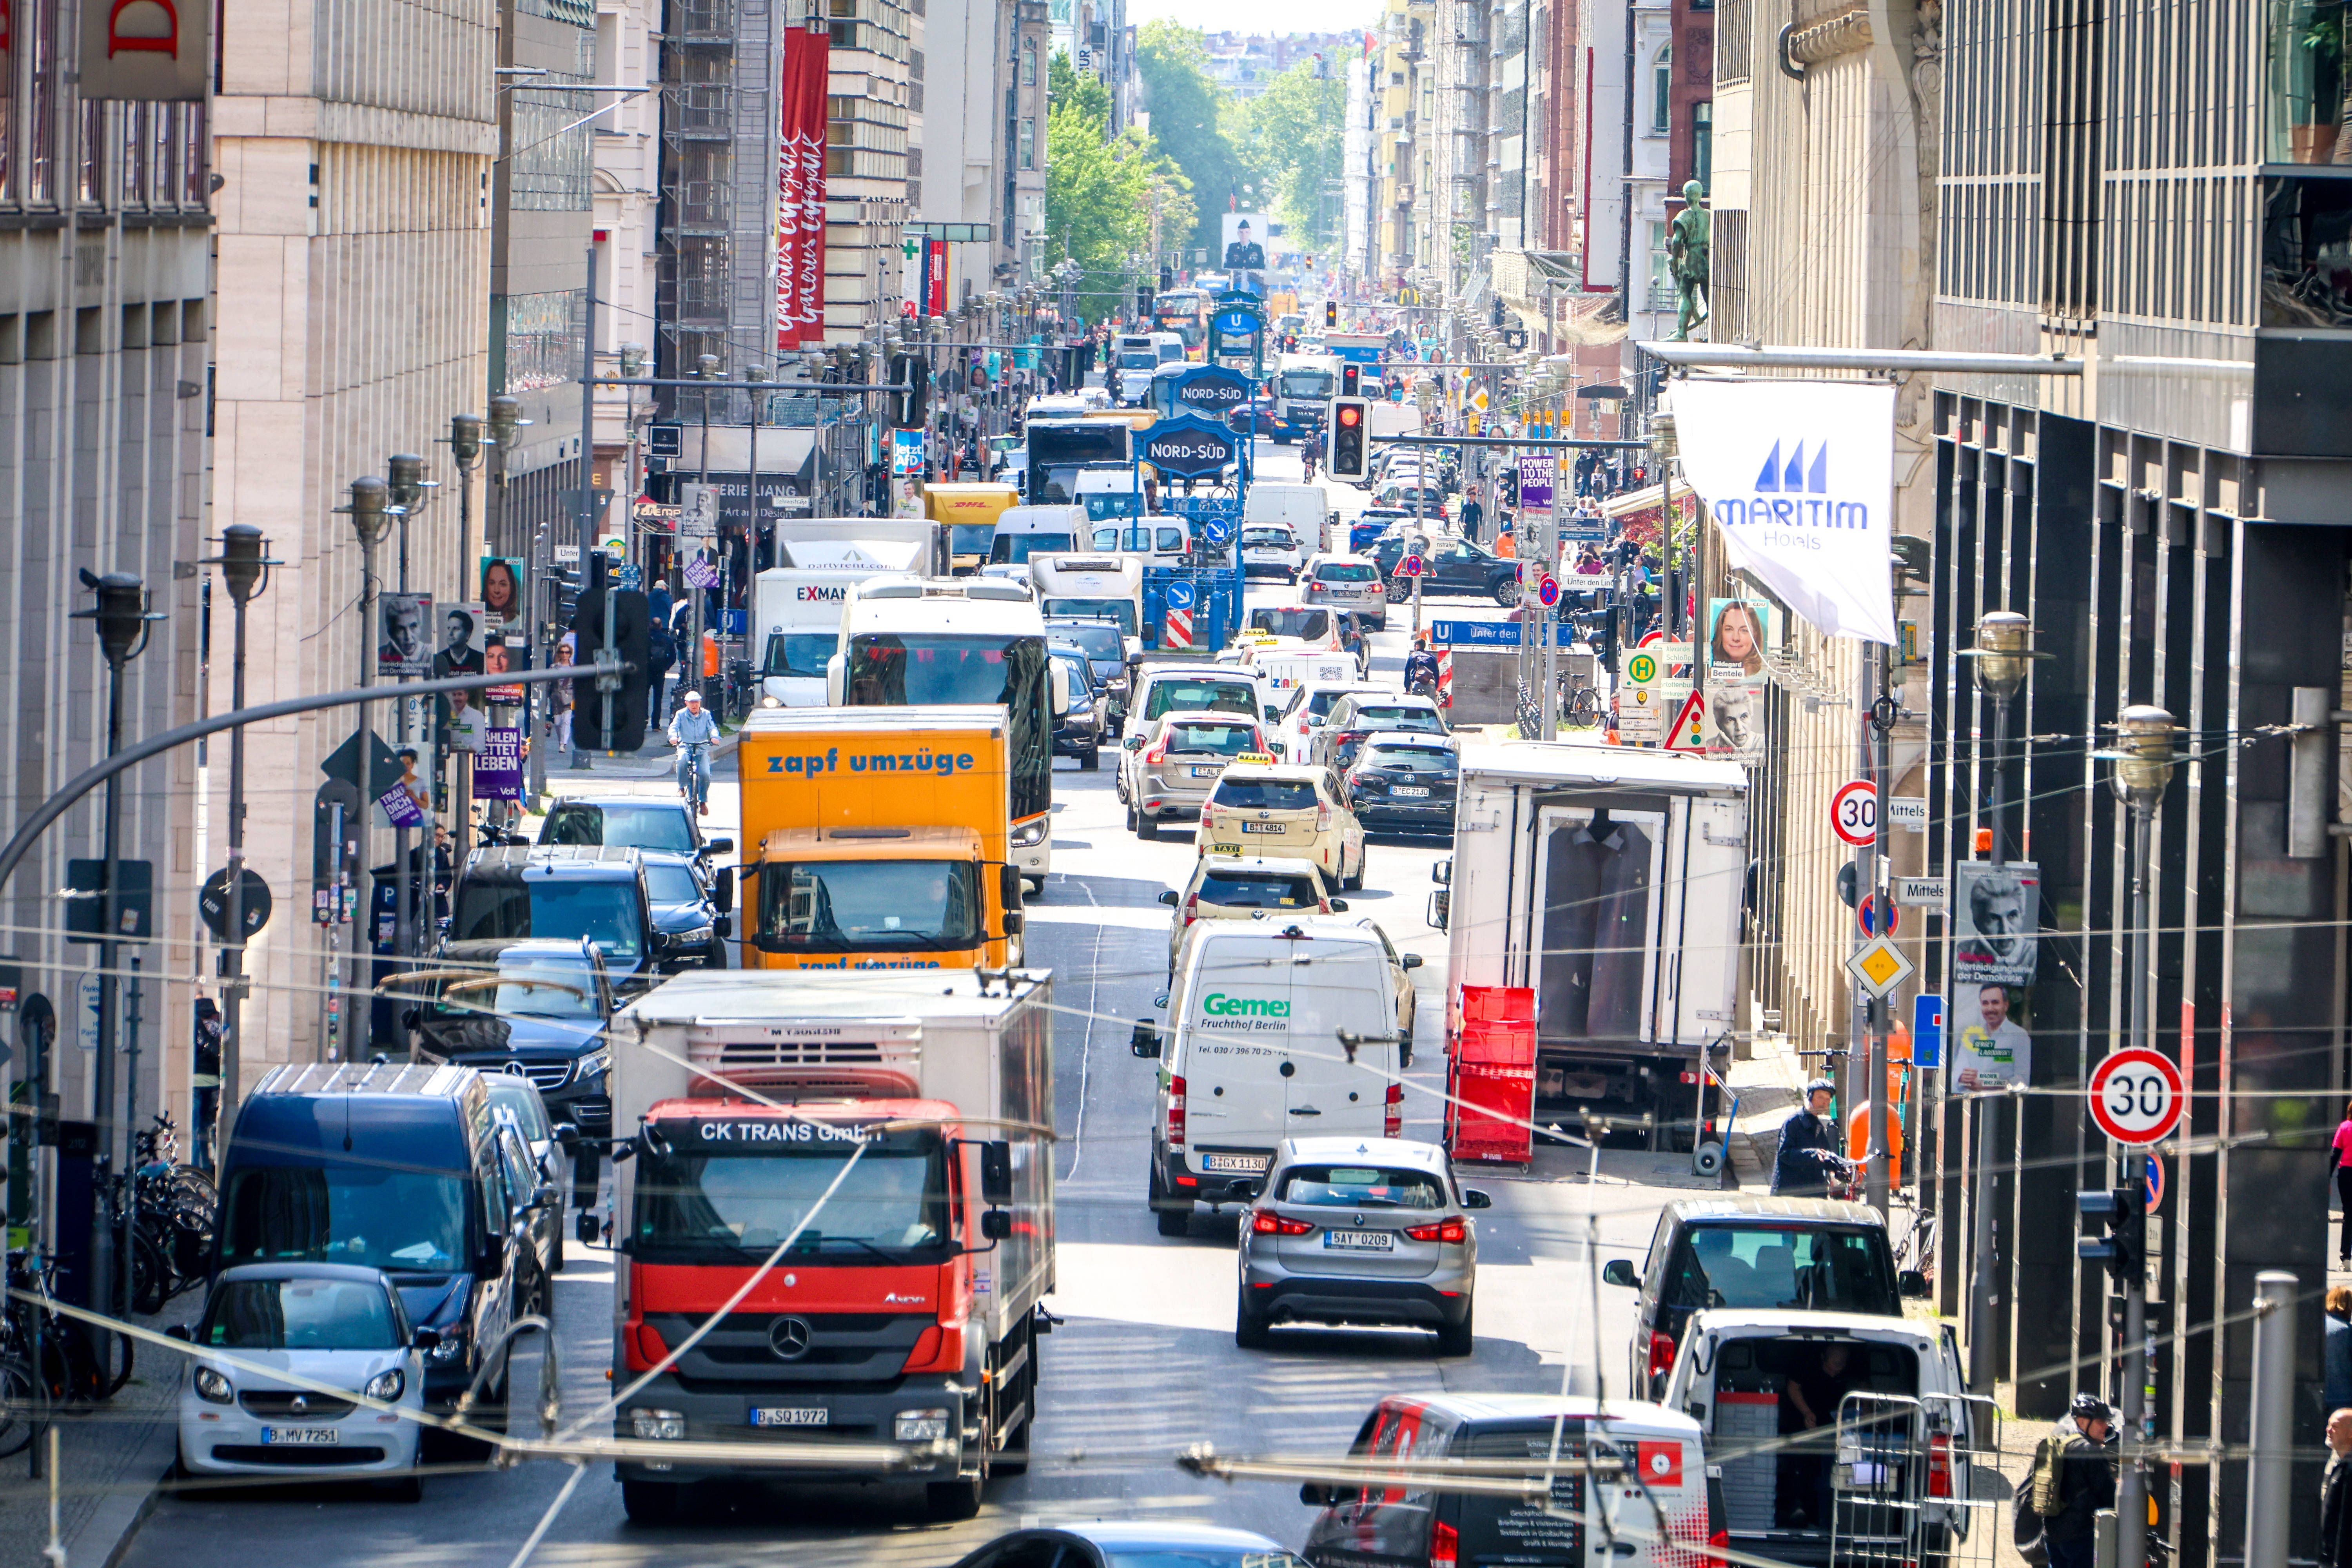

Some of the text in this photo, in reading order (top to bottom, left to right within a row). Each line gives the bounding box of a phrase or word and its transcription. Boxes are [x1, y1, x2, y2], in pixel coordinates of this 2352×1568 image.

[1231, 314, 1241, 327] U
[1183, 387, 1241, 400] NORD-SÜD
[895, 443, 922, 455] Jetzt
[1151, 443, 1226, 459] NORD-SÜD
[895, 455, 918, 466] AfD
[1522, 459, 1554, 468] POWER
[1522, 468, 1553, 478] TO THE
[720, 484, 797, 497] ERIE LIANG
[725, 508, 792, 519] Art Design
[1715, 497, 1868, 530] MARITIM
[686, 559, 704, 578] TRAU
[1588, 577, 1599, 586] den
[1436, 624, 1517, 639] U Unter den
[1636, 661, 1649, 677] H
[1272, 678, 1299, 688] ZAS
[475, 756, 517, 771] LEBEN
[767, 747, 974, 779] zapf umzüge
[381, 785, 405, 807] TRAU
[500, 787, 517, 796] Volt
[385, 795, 412, 815] DICH
[1843, 798, 1876, 828] 30
[385, 887, 394, 902] P
[1957, 962, 2034, 973] Verteidigungslinie
[1201, 1018, 1286, 1031] Fruchthof Berlin
[1198, 1046, 1212, 1054] Tel.
[1214, 1046, 1229, 1054] 030
[1235, 1047, 1250, 1055] 396
[2111, 1075, 2163, 1116] 30
[701, 1123, 731, 1141] CK
[737, 1123, 811, 1141] TRANS
[1210, 1157, 1265, 1169] B GX 1130
[1334, 1233, 1388, 1246] 5AY 0209
[757, 1410, 826, 1425] B SQ 1972
[269, 1430, 336, 1442] B MV 7251
